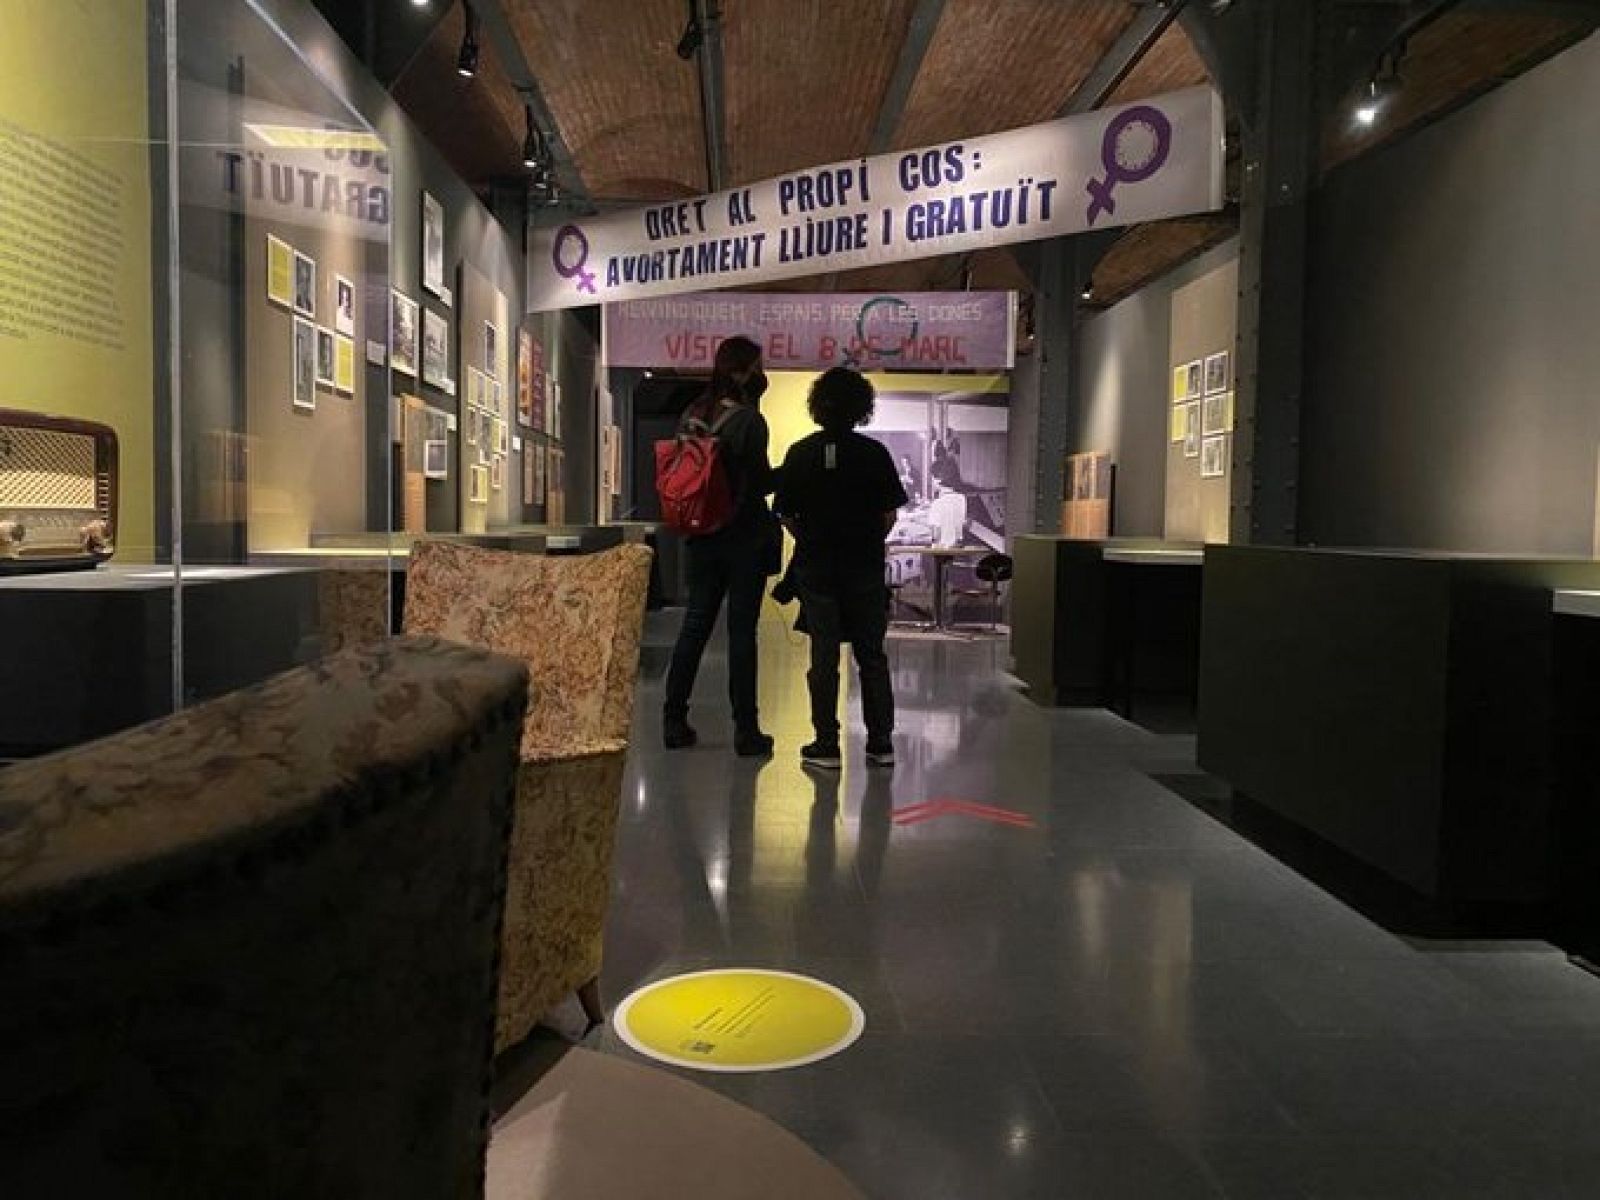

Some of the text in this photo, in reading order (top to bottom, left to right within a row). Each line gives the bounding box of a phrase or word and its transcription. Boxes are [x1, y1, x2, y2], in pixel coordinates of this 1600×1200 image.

[646, 200, 706, 240] DRET
[729, 188, 756, 226] AL
[900, 145, 981, 191] COS:
[606, 234, 766, 287] AVORTAMENT
[882, 209, 891, 245] I
[906, 178, 1057, 241] GRATUÏT
[929, 304, 982, 321] DONES
[769, 333, 800, 360] EL
